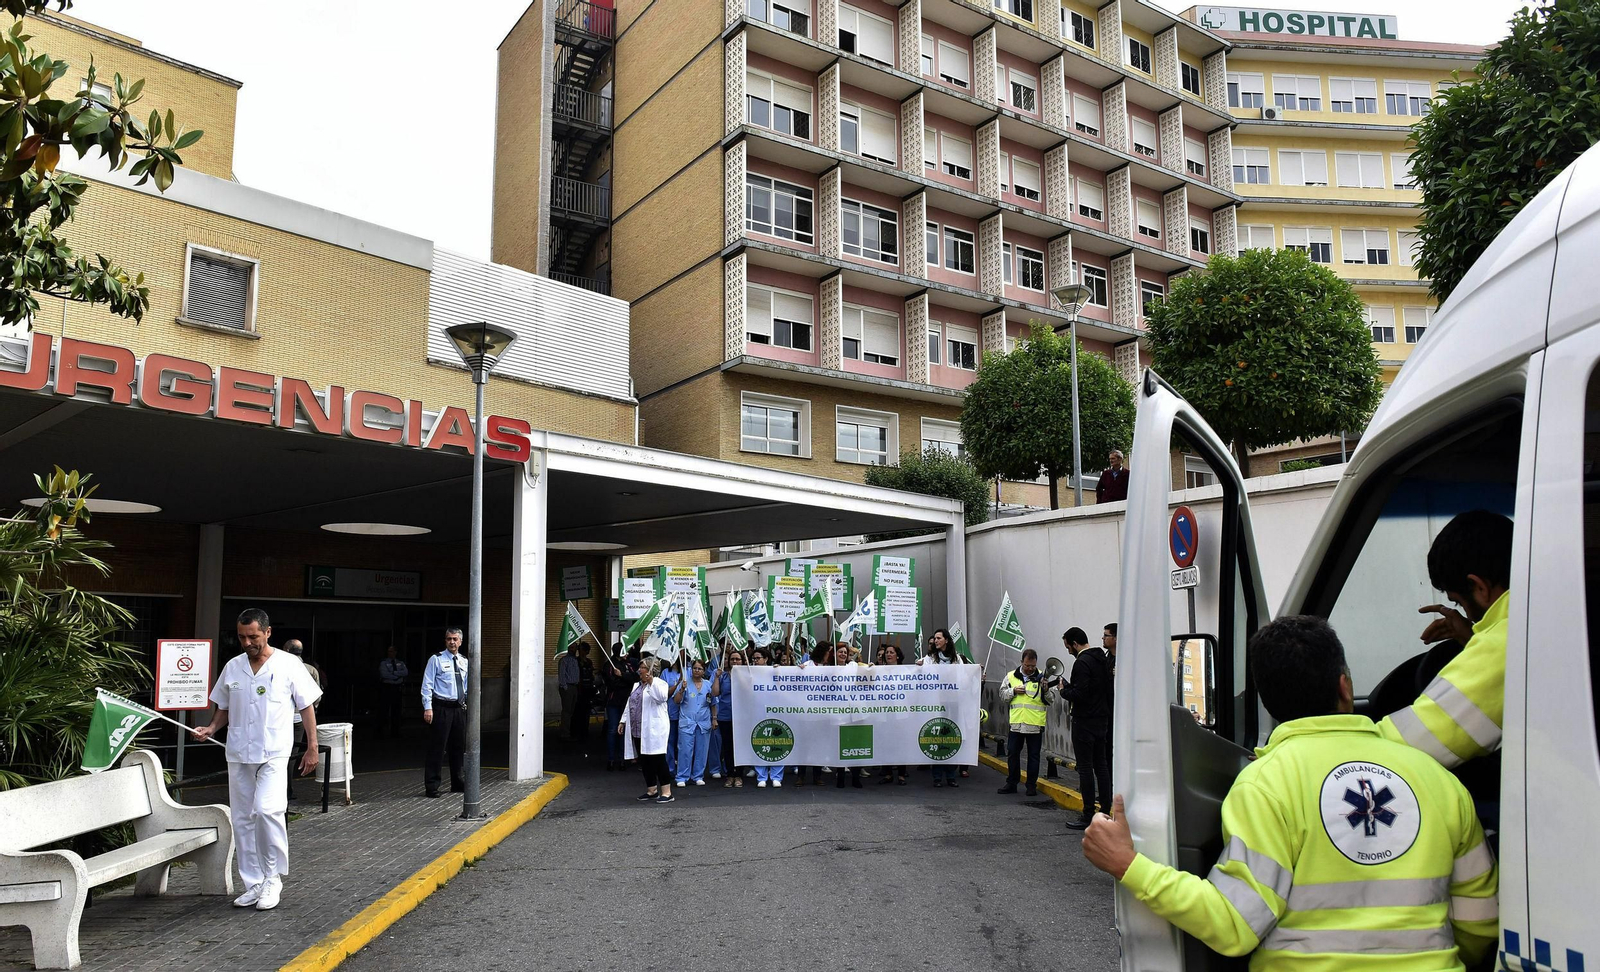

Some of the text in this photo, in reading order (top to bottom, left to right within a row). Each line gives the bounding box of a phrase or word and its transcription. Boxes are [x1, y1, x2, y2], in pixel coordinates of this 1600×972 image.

[1239, 11, 1397, 39] HOSPITAL
[375, 573, 415, 585] Urgencias
[773, 674, 829, 682] ENFERMERÍA
[883, 673, 939, 682] SATURACIÓN
[780, 683, 842, 692] OBSERVACIÓN
[845, 684, 895, 692] URGENCIAS
[807, 694, 848, 702] GENERAL
[878, 692, 905, 700] ROCÍO
[766, 706, 784, 714] POR
[786, 706, 805, 714] UNA
[807, 706, 859, 714] ASISTENCIA
[762, 727, 772, 736] 47
[930, 726, 941, 735] 47
[756, 751, 766, 759] POR
[774, 750, 789, 761] SALUD
[842, 748, 871, 756] SATSE
[924, 750, 933, 758] POR
[942, 749, 957, 759] SALUD
[1334, 766, 1392, 781] AMBULANCIAS
[1357, 850, 1392, 860] TENORIO
